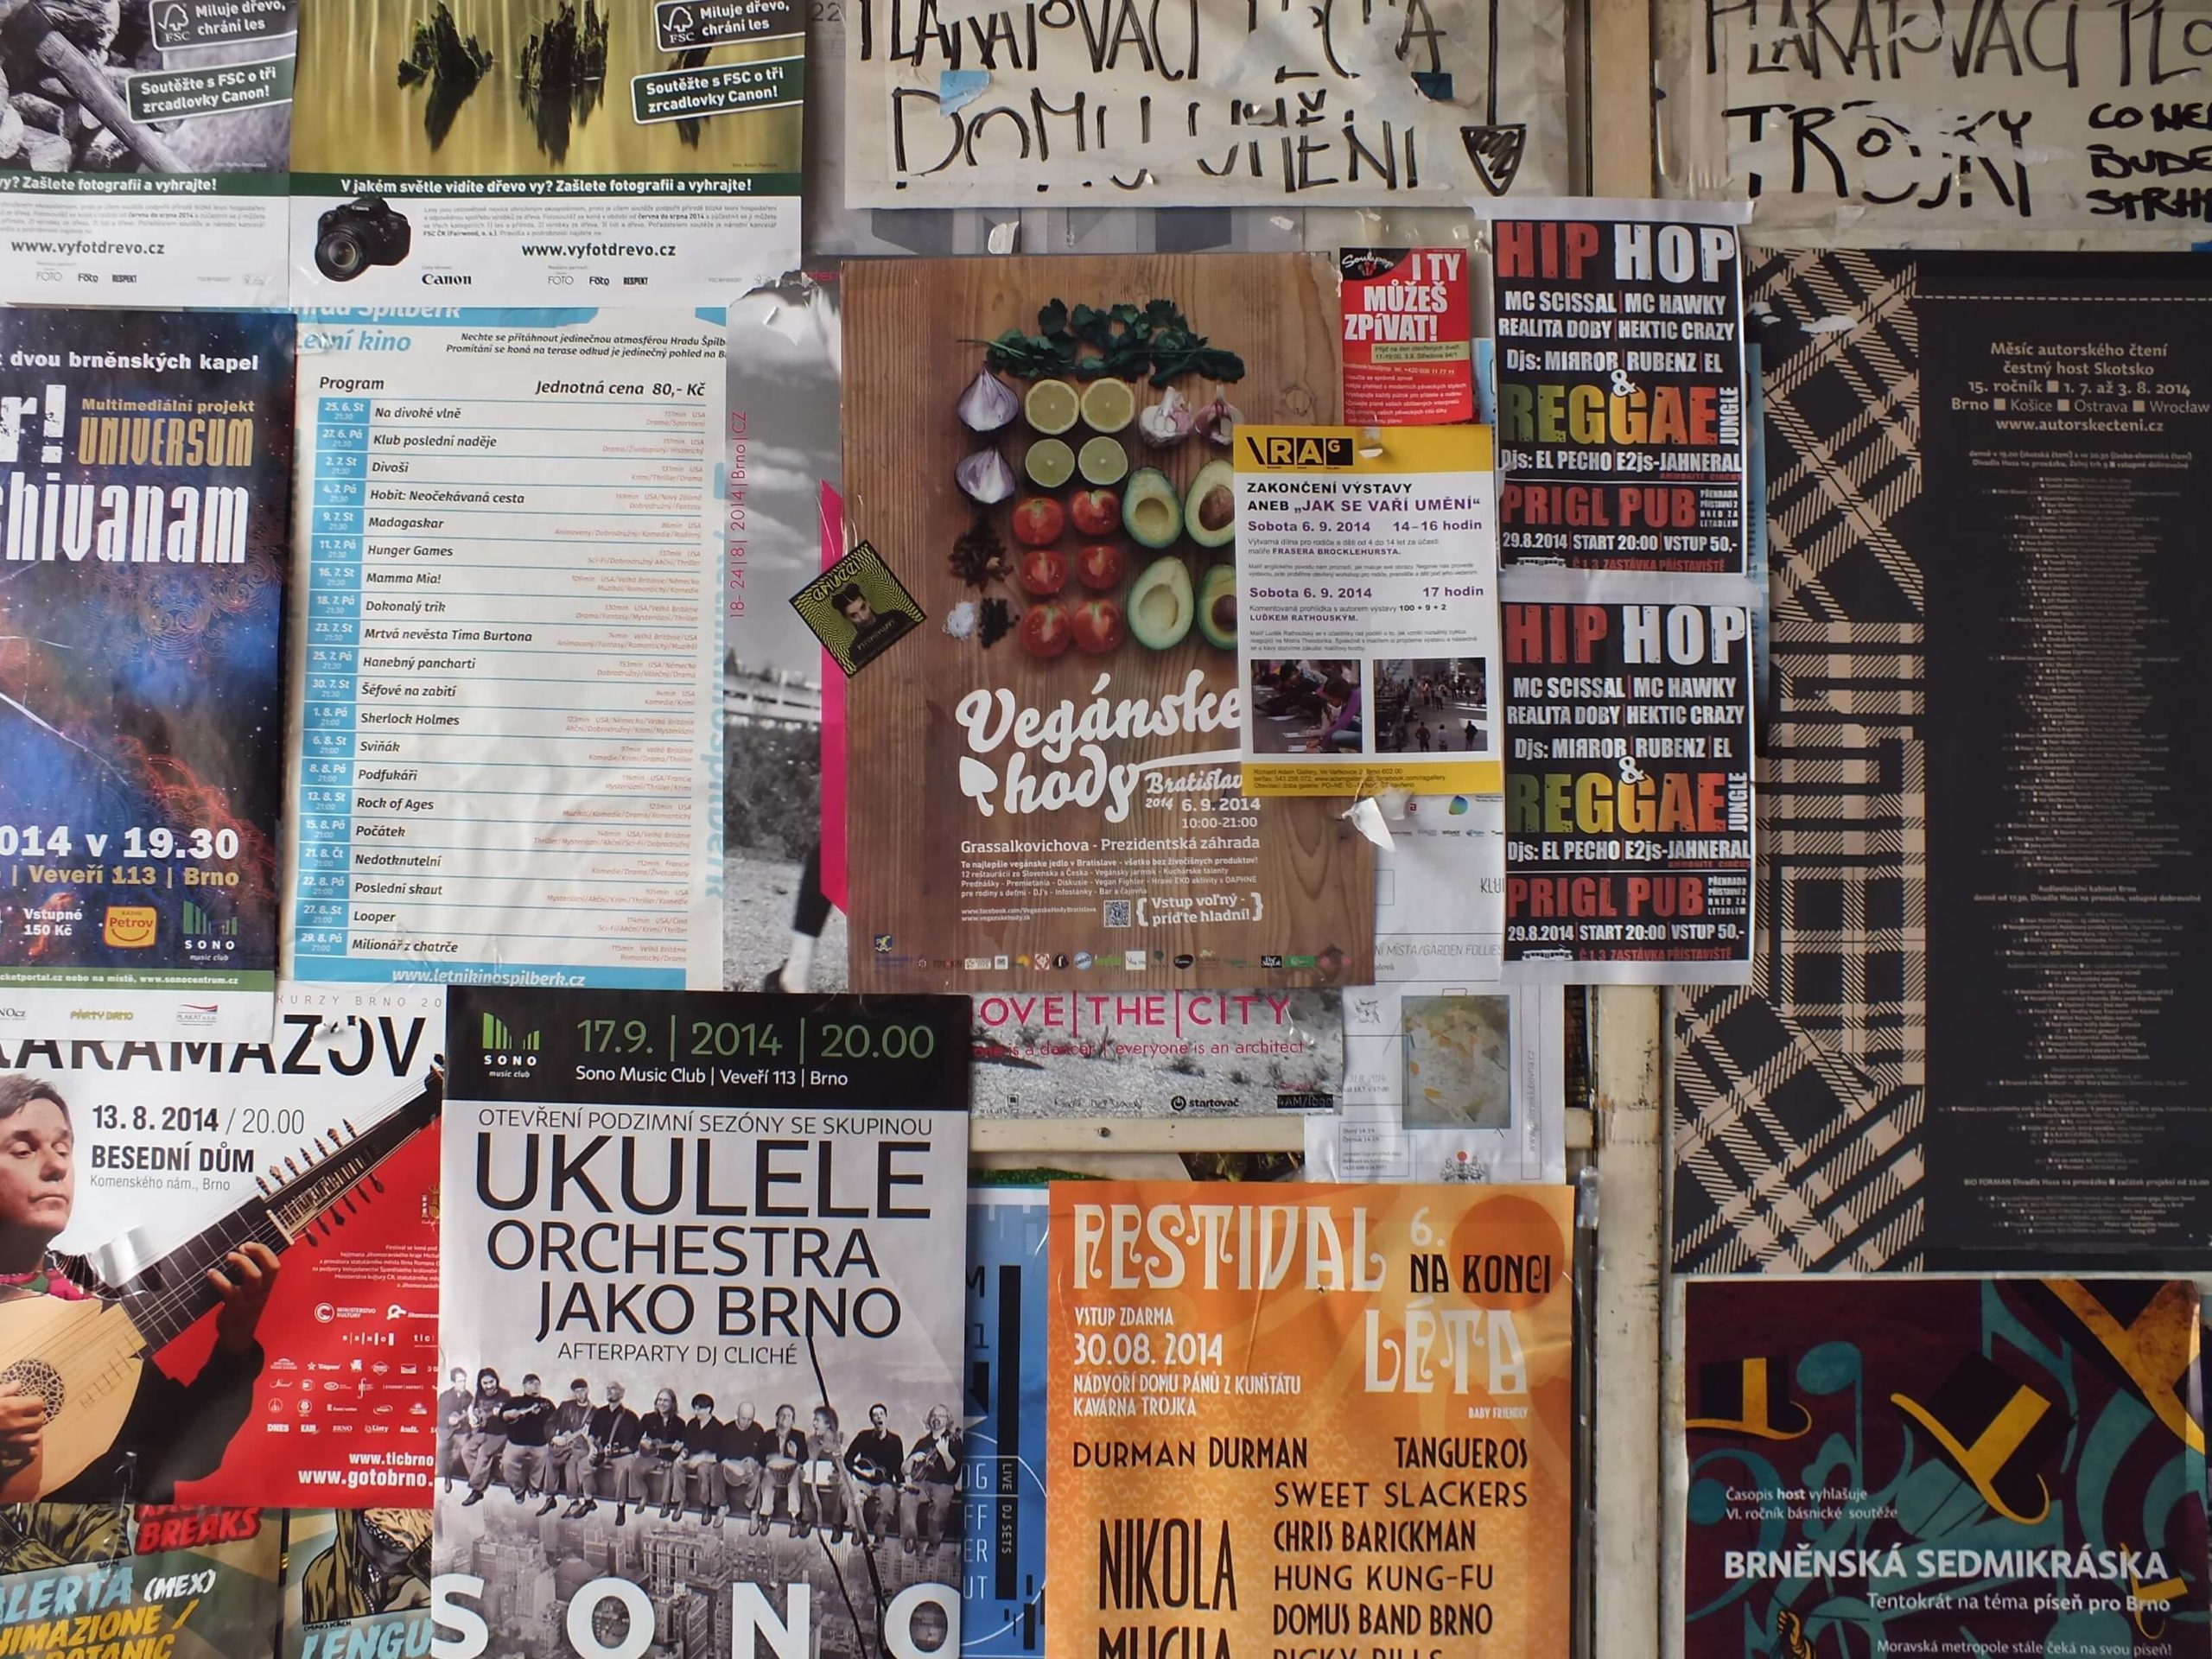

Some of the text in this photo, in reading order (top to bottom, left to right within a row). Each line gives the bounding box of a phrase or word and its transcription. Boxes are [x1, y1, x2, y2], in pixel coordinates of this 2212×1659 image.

[646, 77, 708, 95] Soutěžte
[712, 78, 720, 86] s
[724, 72, 751, 85] FSC
[766, 67, 784, 80] tři
[648, 86, 778, 113] zrcadlovky Canon!
[341, 178, 752, 195] V jakém světle vidíte dřevo vy? Zašlete fotografii a vyhrajte!
[11, 240, 164, 256] www.vyfotdrevo.cz
[522, 244, 676, 258] www.vyfotdrevo.cz
[1496, 222, 1734, 283] HIP HOP
[423, 274, 472, 285] Canon
[1412, 254, 1460, 281] I TY
[1364, 279, 1447, 312] MŮŽEŠ
[1344, 315, 1437, 341] ZPÍVAT!
[1499, 319, 1733, 340] REALITA DOBY HEKTIC CRAZY
[10, 351, 257, 372] dvou brněnských kapel
[1991, 342, 2167, 357] Měsíc autorského čtení
[2004, 361, 2154, 377] čestný host Skotsko
[320, 377, 705, 398] Program Jednotná cena 80,- Kč
[82, 398, 255, 414] Multimediální projekt
[375, 406, 461, 419] Na divoké vlně
[1501, 384, 1718, 445] REGGAE
[1719, 386, 1739, 445] JUNGLE
[1952, 397, 2209, 413] Brno Košice Ostrava Wrocław
[1996, 419, 2164, 432] www.autorskecteni.cz
[78, 417, 254, 467] UNIVERSUM
[372, 462, 409, 474] Divoši
[1248, 481, 1412, 494] ZAKONČENÍ VÝSTAVY
[1501, 486, 1697, 528] PRIGL PUB
[369, 518, 444, 530] Madagaskar
[1249, 522, 1297, 532] Sobota
[1302, 522, 1314, 532] 6.
[1319, 522, 1332, 532] 9.
[1338, 522, 1370, 532] 2014
[1443, 520, 1482, 531] hodin
[368, 545, 453, 558] Hunger Games
[1503, 533, 1737, 553] 29.8.2014 START 20:00 VSTUP 50,-
[366, 573, 442, 584] Mamma Mia!
[1506, 605, 1745, 664] HIP HOP
[956, 669, 1242, 762] Vegánske
[359, 769, 416, 782] Podfukáři
[1004, 745, 1140, 823] hody
[1507, 772, 1726, 834] REGGAE
[1182, 817, 1257, 829] 10:00-21:00
[86, 827, 238, 859] v 19.30
[962, 836, 1260, 853] Grassalkovichova Prezidentská záhrada
[29, 864, 239, 886] Veveří 113 Brno
[1507, 876, 1703, 918] PRIGL PUB
[110, 918, 153, 928] Petrov
[353, 911, 395, 925] Looper
[392, 969, 585, 988] www.letnikinospilberk.cz
[1085, 995, 1290, 1026] THE CITY
[576, 1020, 935, 1059] 17.9. 2014 20.00
[1115, 1040, 1304, 1058] everyone is an architect
[576, 1065, 848, 1085] Sono Music Club Veveří 113 Brno
[1189, 1097, 1239, 1109] startovač
[162, 1108, 304, 1135] 2014 20.00
[92, 1141, 255, 1173] BESEDNÍ DŮM
[90, 1175, 164, 1189] Komenského
[203, 1179, 231, 1192] Brno
[476, 1133, 931, 1219] UKULELE
[487, 1220, 880, 1279] ORCHESTRA
[1073, 1205, 1384, 1292] FESTIVAL
[536, 1281, 900, 1342] JAKO BRNO
[558, 1342, 797, 1366] AFTERPARTY DJ CLICHÉ
[1075, 1332, 1222, 1365] 30.08. 2014
[1364, 1297, 1528, 1395] LÉTA
[1073, 1436, 1528, 1469] DURMAN DURMAN TANGUEROS
[1275, 1482, 1528, 1508] SWEET SLACKERS
[138, 1509, 260, 1553] BREAKS
[1274, 1520, 1476, 1552] CHRIS BARICKMAN
[1099, 1517, 1237, 1611] NIKOLA
[1725, 1541, 2168, 1580] BRNĚNSKÁ SEDMIKRÁSKA
[144, 1569, 217, 1602] (MEX)
[1867, 1592, 2171, 1615] Tentokrát na téma píseň pro Brno
